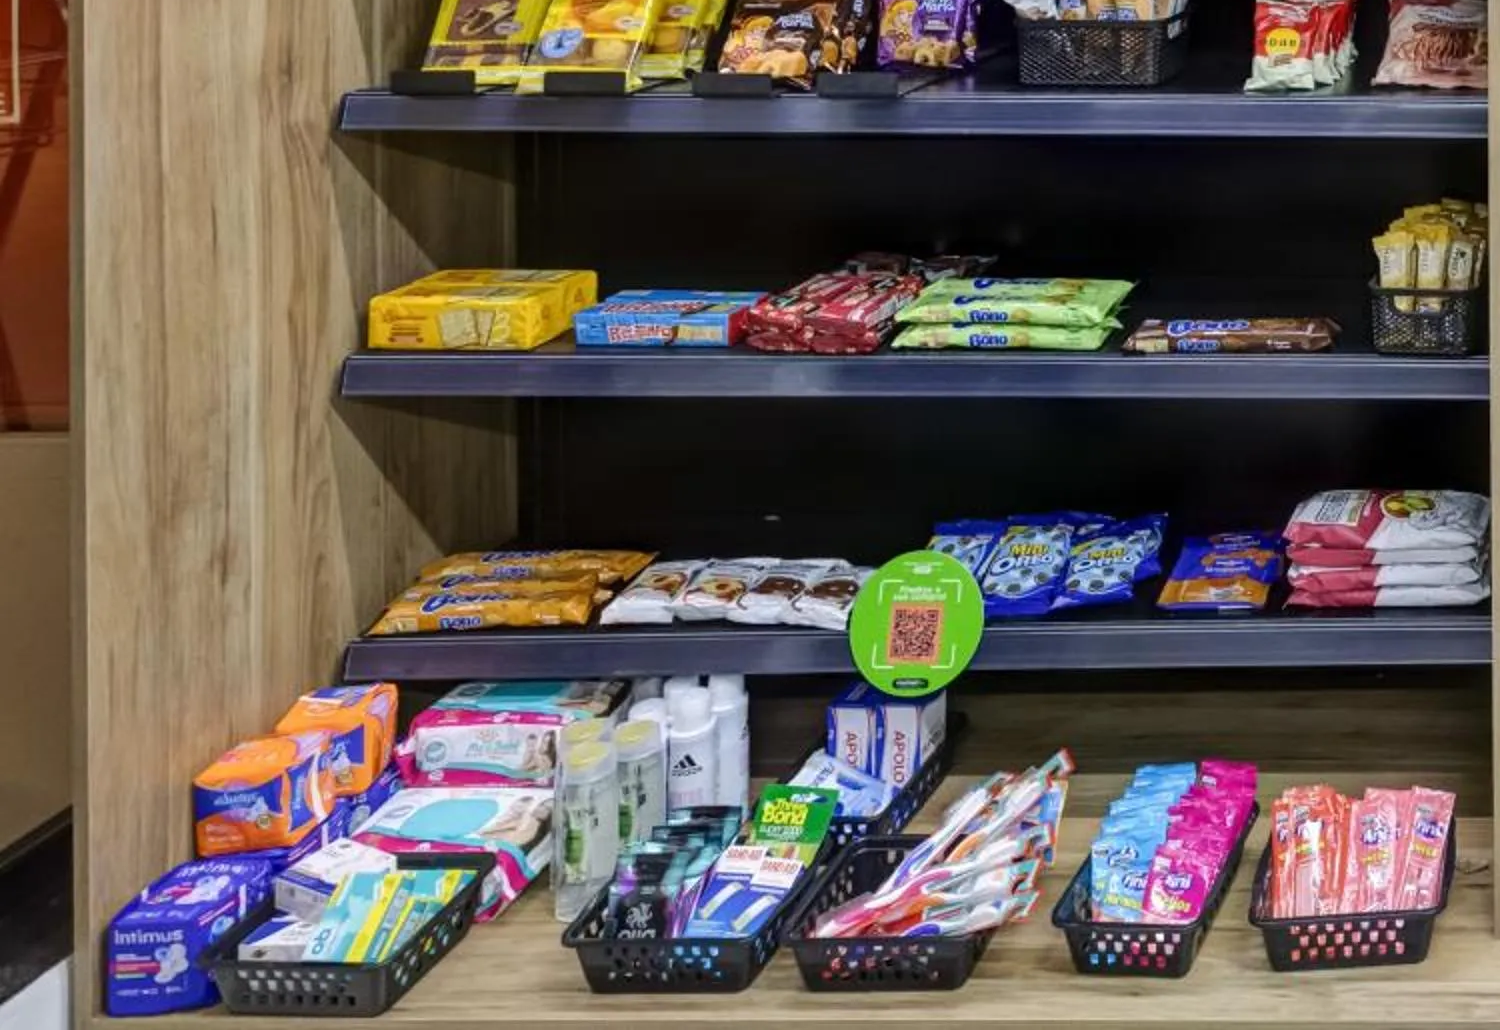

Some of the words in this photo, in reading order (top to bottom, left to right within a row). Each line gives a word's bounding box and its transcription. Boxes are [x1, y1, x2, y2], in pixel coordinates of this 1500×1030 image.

[844, 730, 858, 770] APO
[892, 729, 907, 784] APOLO
[761, 806, 811, 826] Bond
[113, 926, 184, 945] intimus
